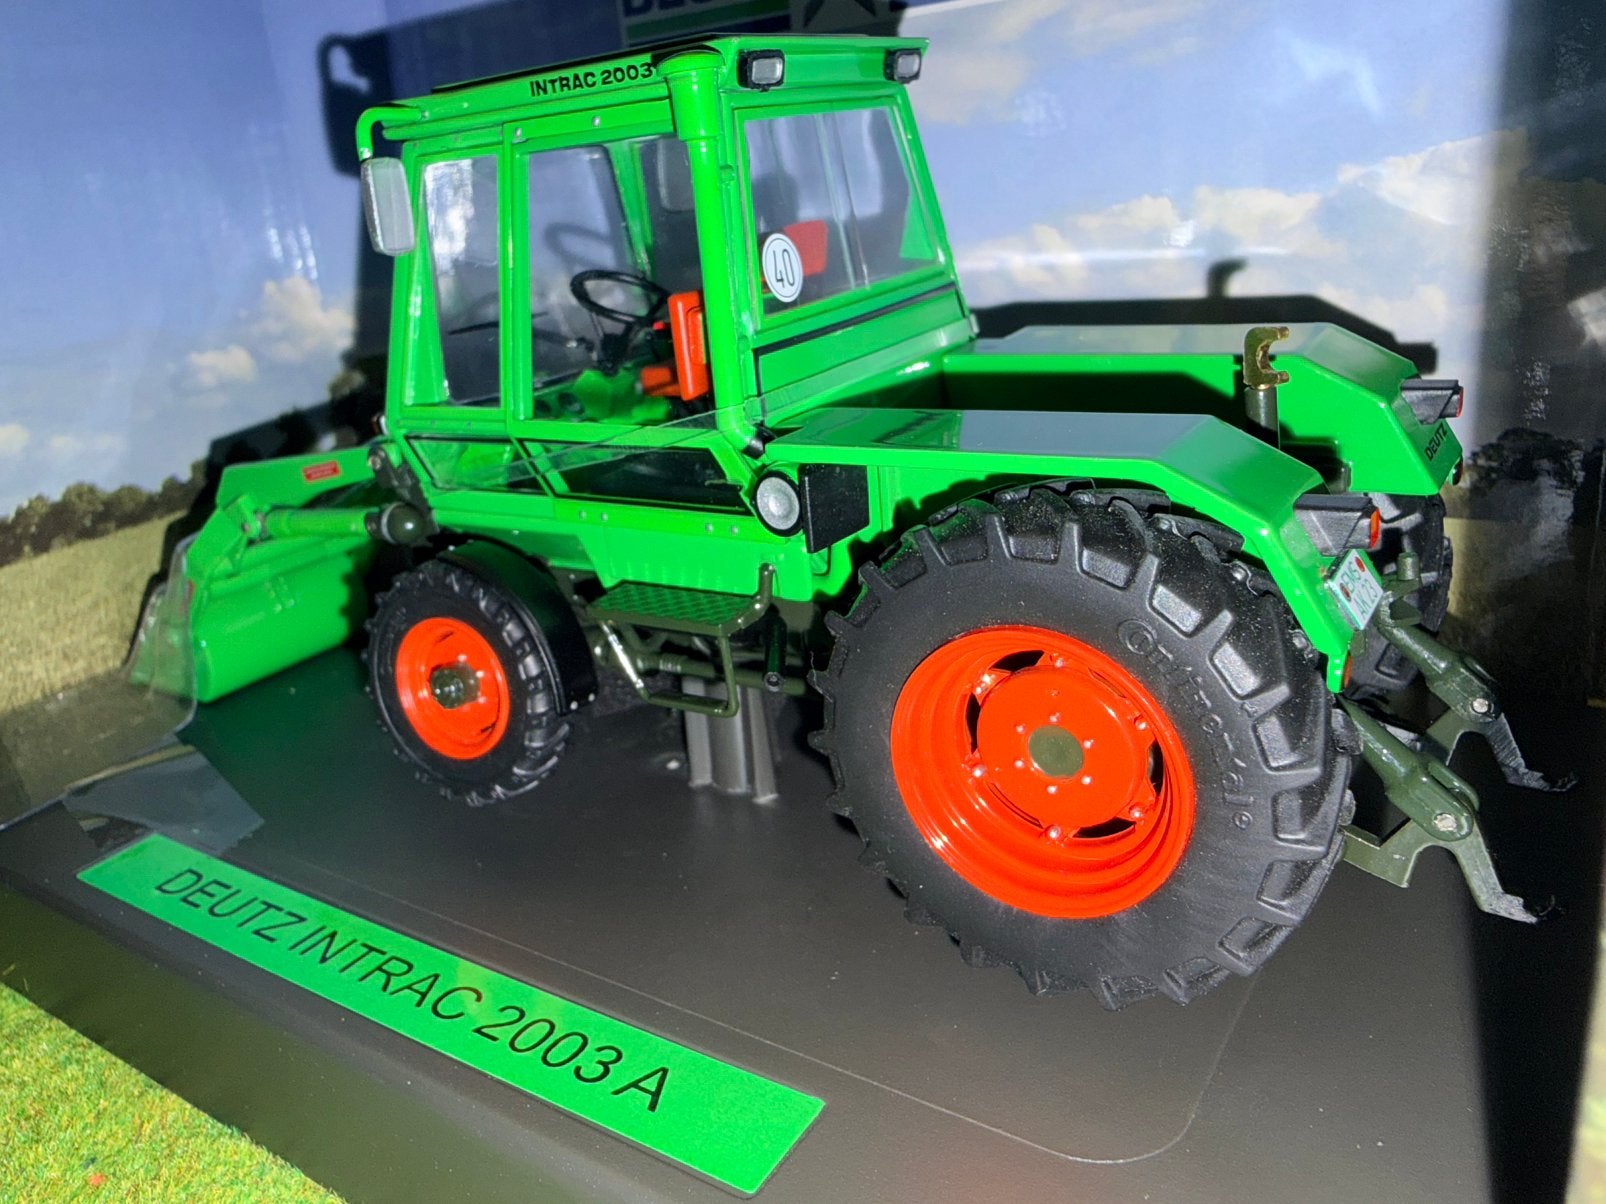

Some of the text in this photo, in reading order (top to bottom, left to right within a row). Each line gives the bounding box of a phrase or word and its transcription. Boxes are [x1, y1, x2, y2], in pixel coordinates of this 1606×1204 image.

[529, 62, 653, 97] INTRAC 2003
[772, 248, 795, 289] 40
[1424, 422, 1448, 461] DEUTZ
[154, 868, 670, 1113] DEUTZ INTRAC 2003 A
